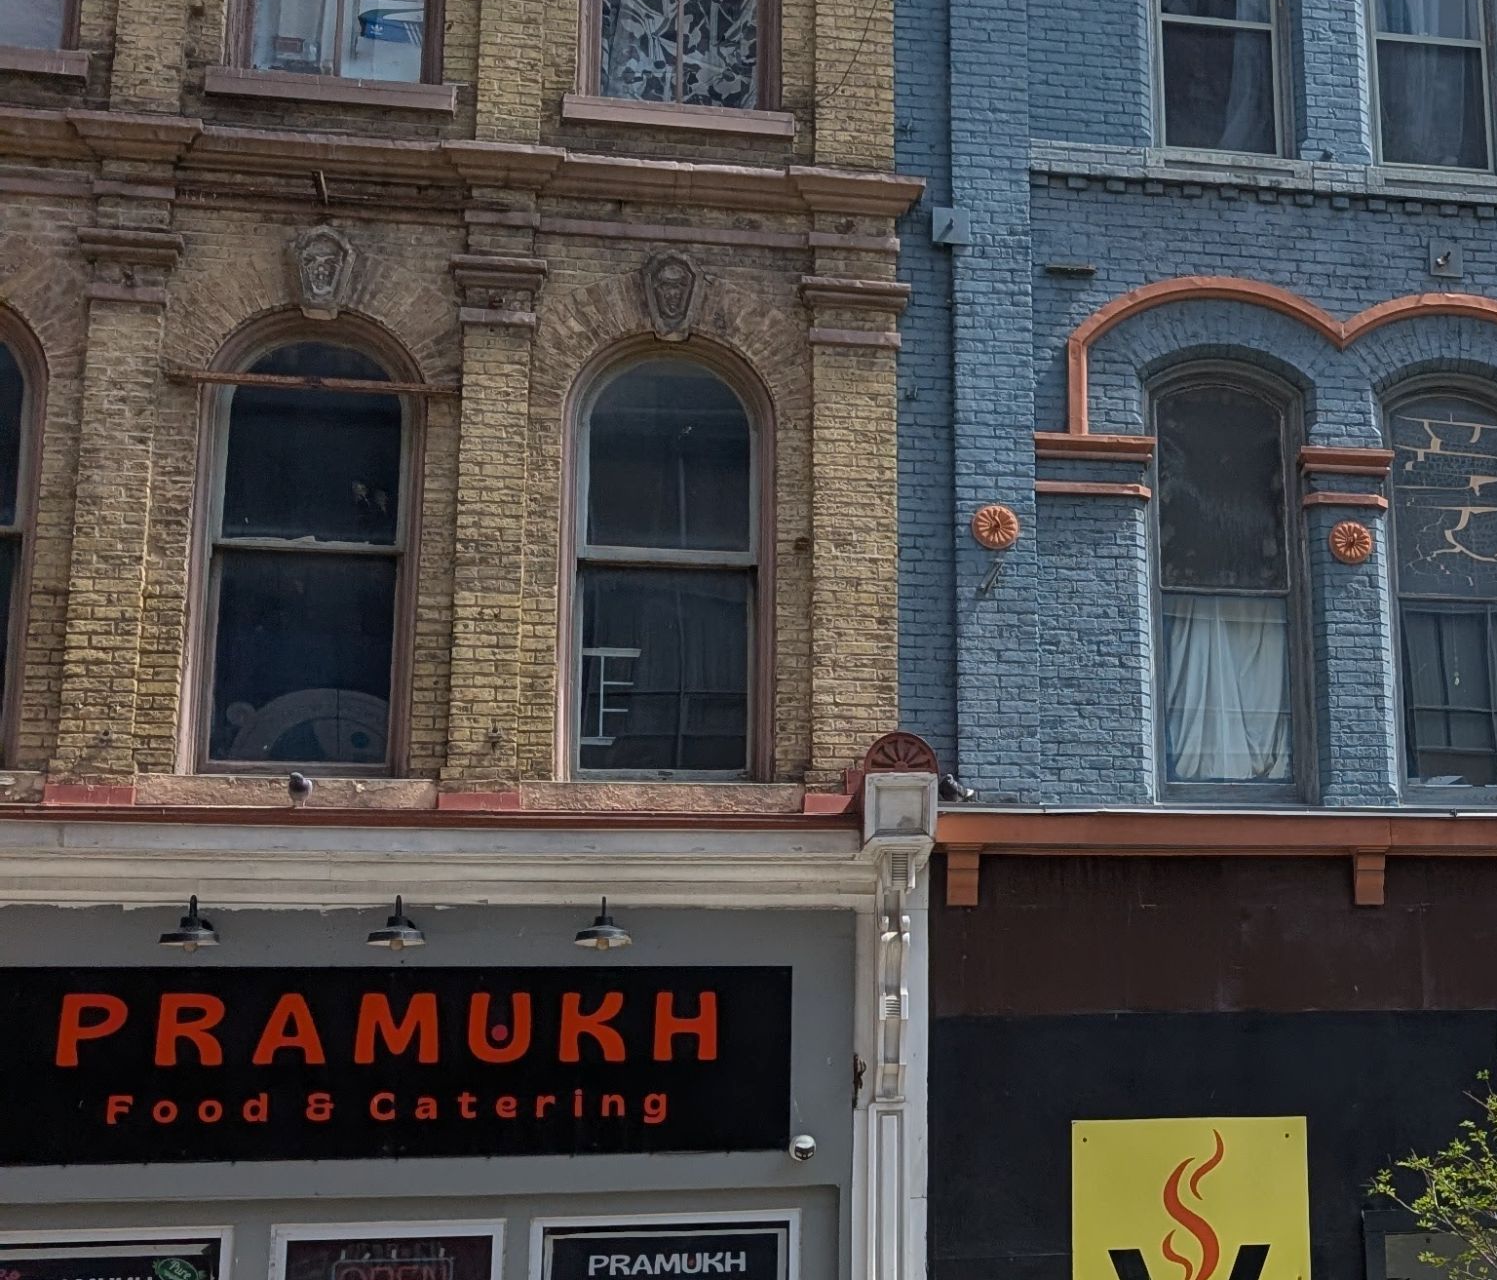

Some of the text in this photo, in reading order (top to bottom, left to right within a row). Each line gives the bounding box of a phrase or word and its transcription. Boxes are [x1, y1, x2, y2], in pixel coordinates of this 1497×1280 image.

[55, 990, 719, 1067] PRAMUKH
[106, 1088, 668, 1126] Food & Catering
[588, 1251, 747, 1276] PRAMUKH
